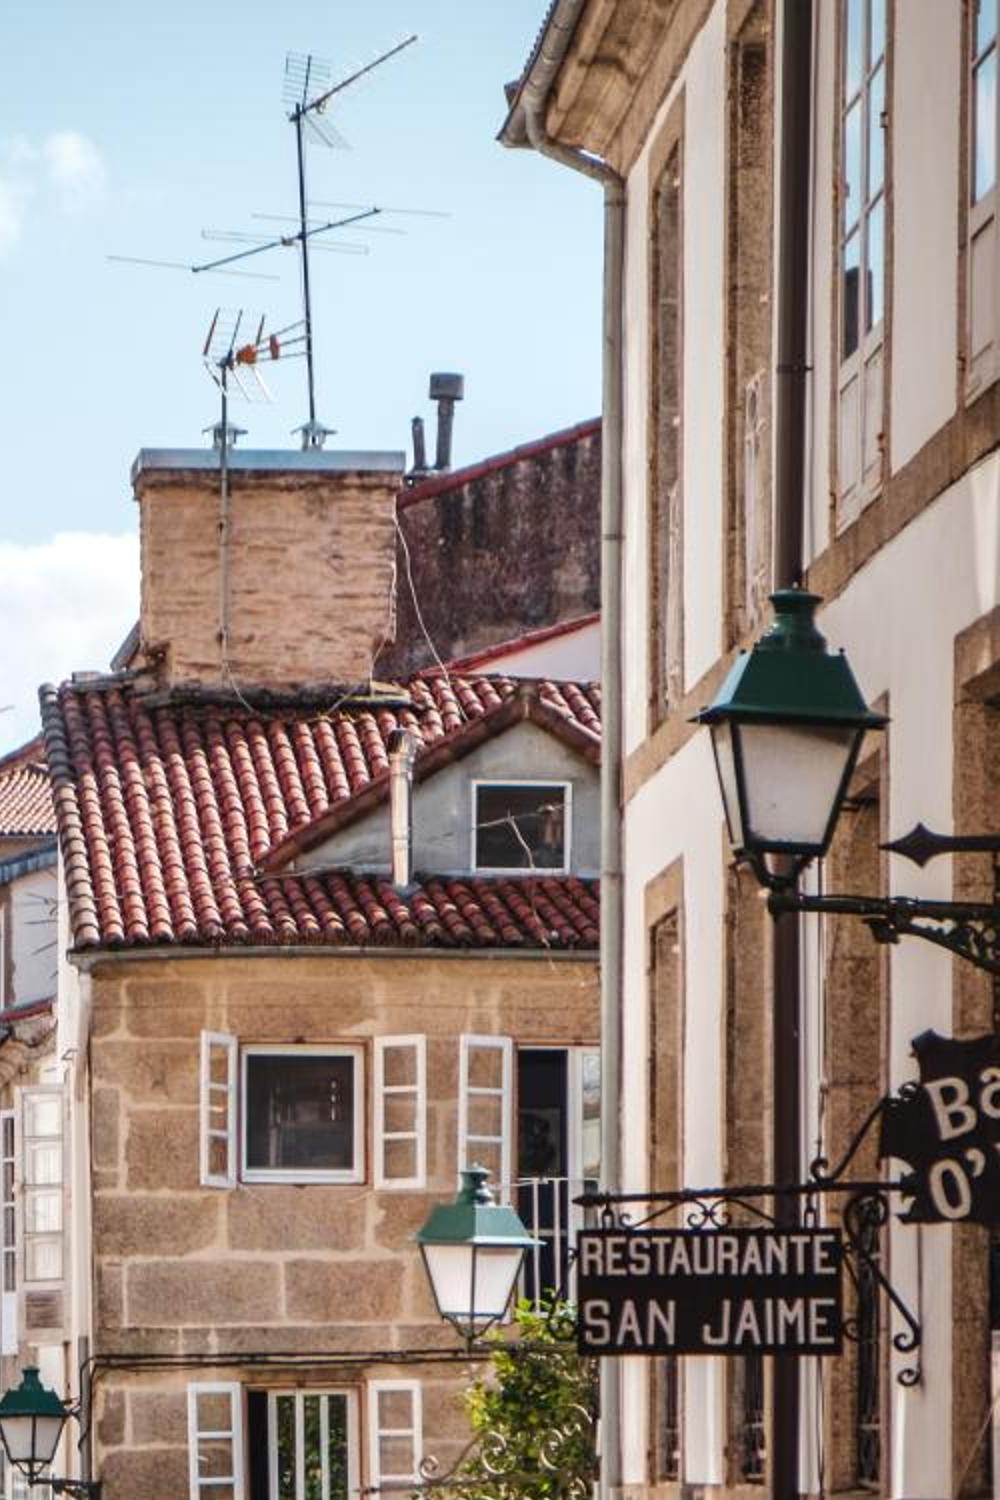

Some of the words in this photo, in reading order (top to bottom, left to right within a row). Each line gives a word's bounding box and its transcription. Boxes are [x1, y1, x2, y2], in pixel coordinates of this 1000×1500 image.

[929, 1145, 998, 1219] O'
[580, 1235, 836, 1276] RESTAURANTE
[584, 1299, 675, 1346] SAN
[702, 1299, 835, 1346] JAIME
